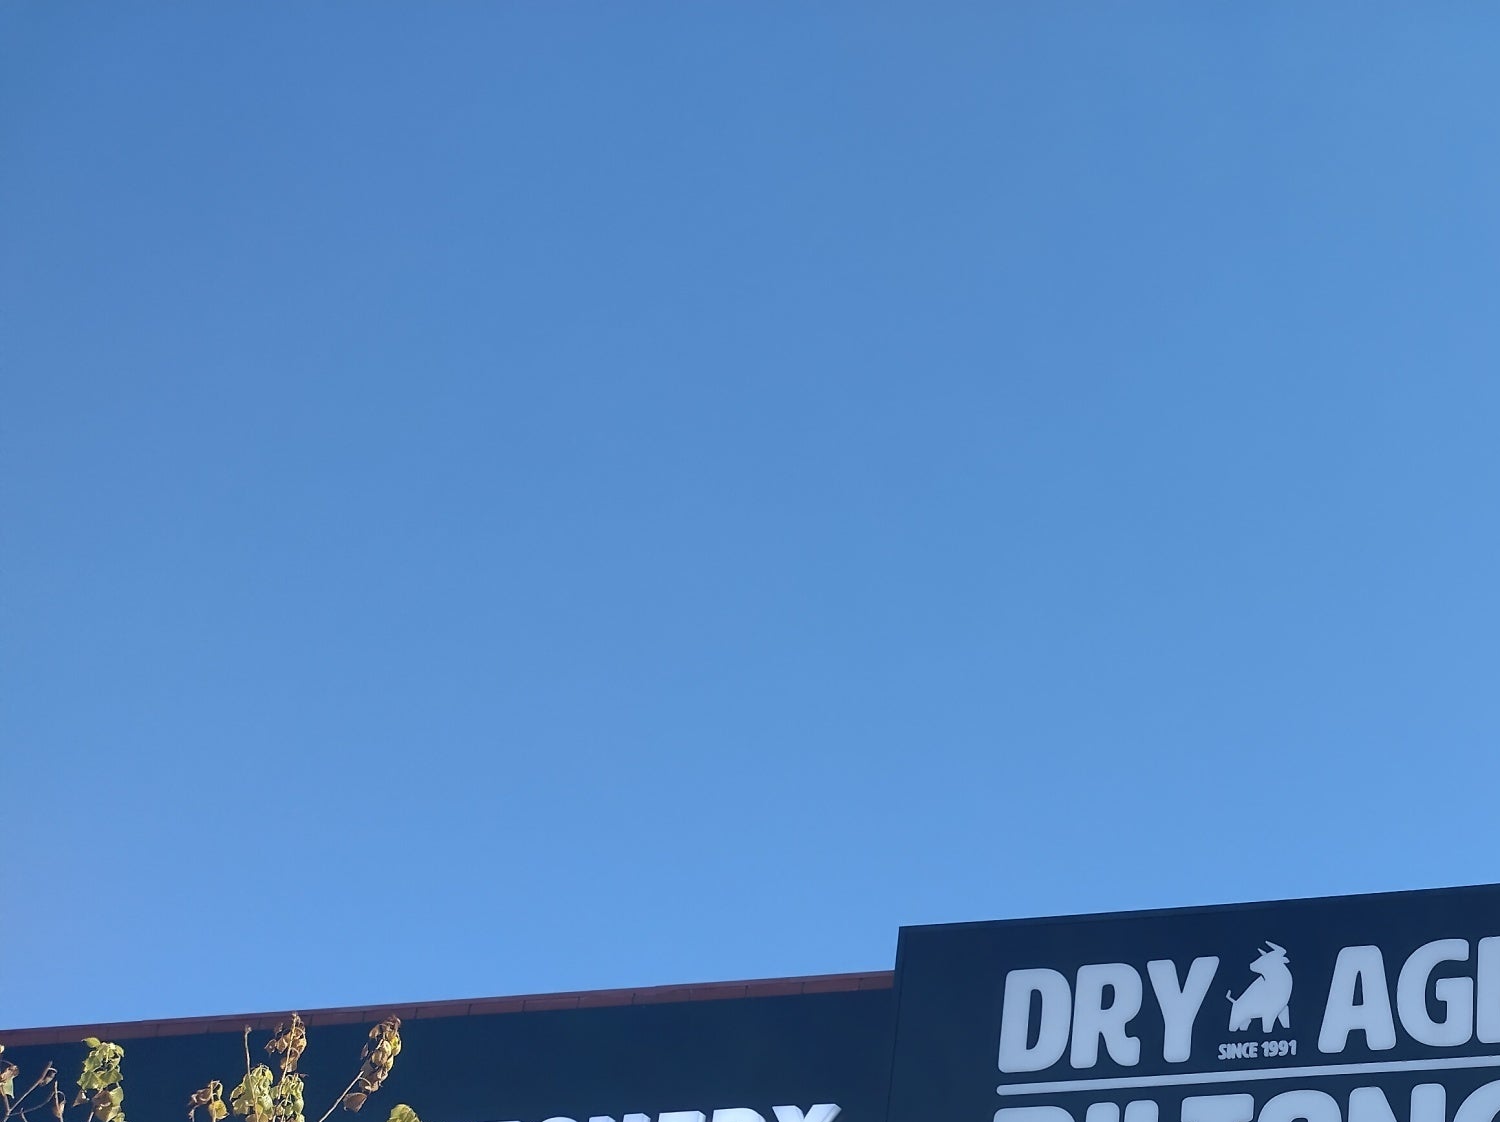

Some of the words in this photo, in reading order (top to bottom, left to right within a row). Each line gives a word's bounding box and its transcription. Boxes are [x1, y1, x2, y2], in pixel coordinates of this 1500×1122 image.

[998, 956, 1220, 1073] DRY
[1218, 1042, 1258, 1060] SINCE
[1261, 1039, 1297, 1057] 1991
